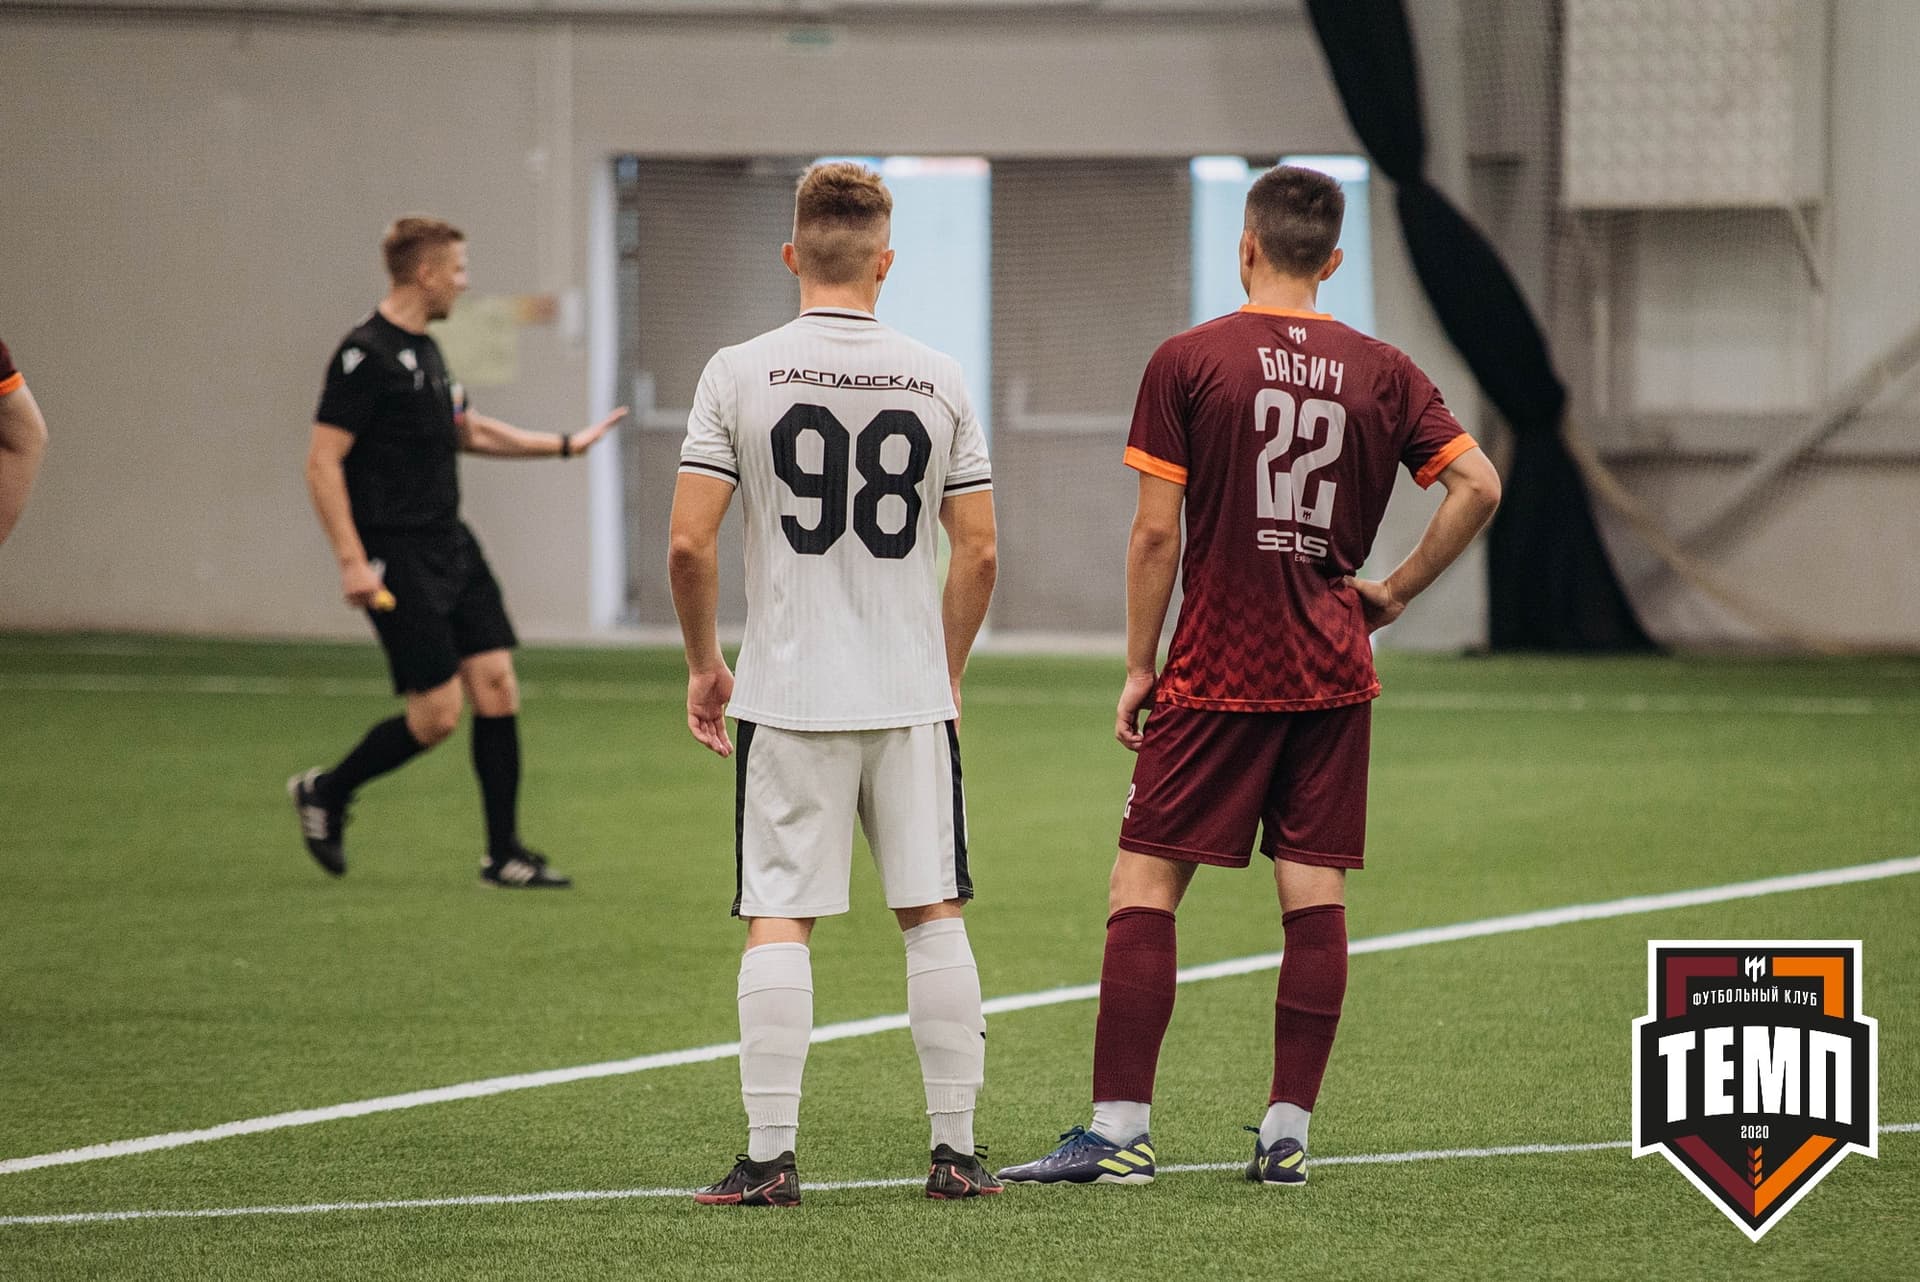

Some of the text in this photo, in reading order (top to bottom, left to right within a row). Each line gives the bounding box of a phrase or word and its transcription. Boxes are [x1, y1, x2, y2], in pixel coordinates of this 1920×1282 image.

[769, 368, 934, 398] РАСПАДСКАЯ
[1257, 347, 1344, 395] БАБИЧ
[770, 402, 932, 559] 98
[1254, 388, 1346, 530] 22
